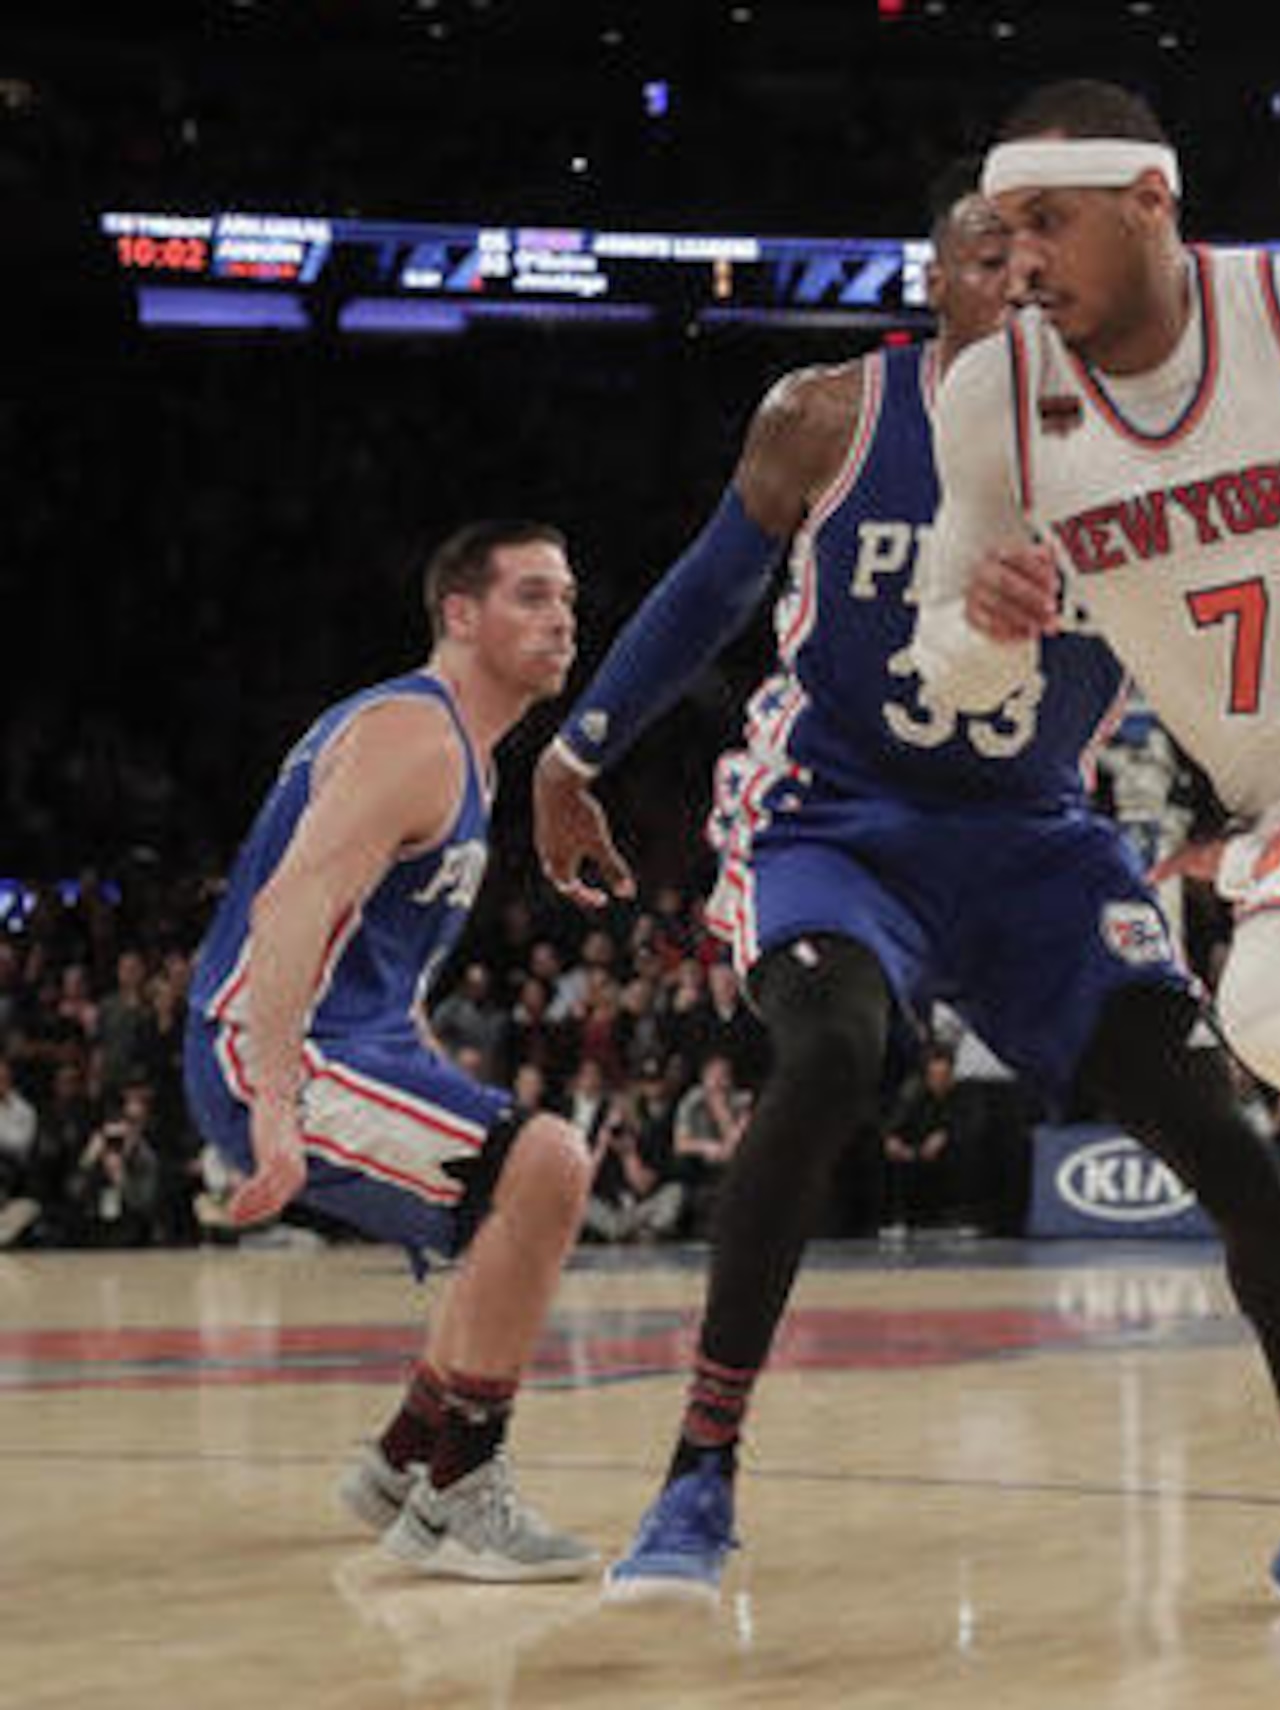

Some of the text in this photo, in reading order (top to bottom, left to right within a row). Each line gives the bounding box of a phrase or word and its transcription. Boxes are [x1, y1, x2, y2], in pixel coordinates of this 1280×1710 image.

[117, 236, 207, 270] 10:02
[1187, 577, 1269, 714] 7
[882, 648, 1045, 758] 33
[1082, 1156, 1184, 1202] KIA
